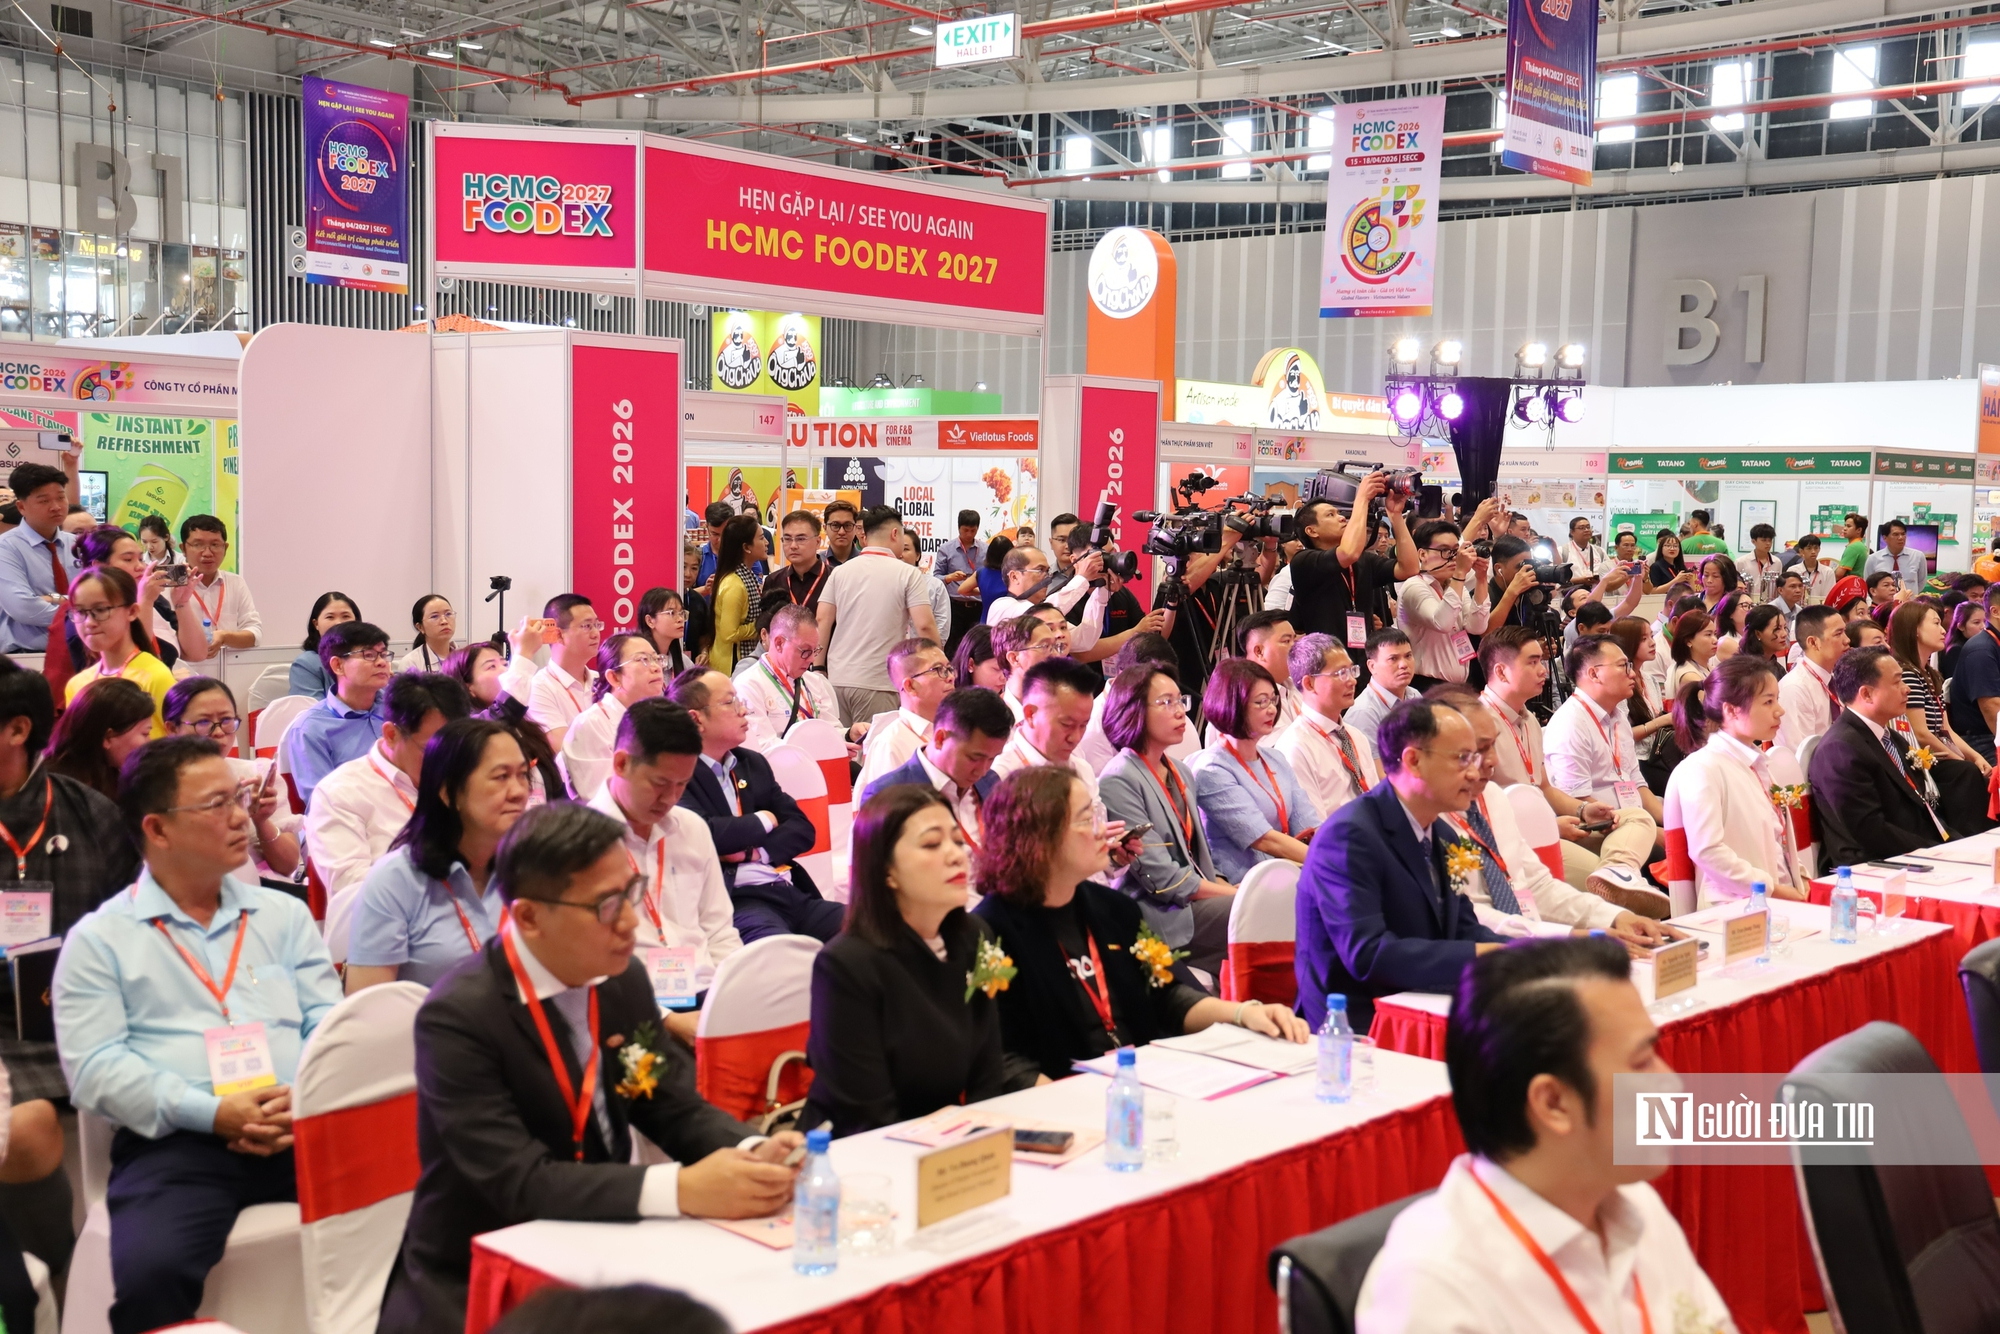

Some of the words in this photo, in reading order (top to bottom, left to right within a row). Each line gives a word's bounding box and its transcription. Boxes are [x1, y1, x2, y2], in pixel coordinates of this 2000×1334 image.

[954, 21, 1000, 46] EXIT
[957, 47, 979, 57] HALL
[982, 45, 992, 54] B1
[1525, 61, 1542, 77] Tháng
[1542, 67, 1563, 82] 04/2027
[1566, 75, 1579, 87] SECC
[318, 100, 331, 108] HẸN
[331, 101, 342, 110] GẶP
[343, 104, 352, 112] LẠI
[366, 108, 377, 116] YOU
[1353, 120, 1395, 135] HCMC
[1397, 122, 1420, 132] 2026
[329, 141, 368, 158] HCMC
[1402, 154, 1418, 162] SECC
[76, 142, 182, 243] B1
[341, 175, 376, 194] 2027
[463, 174, 560, 202] HCMC
[561, 184, 612, 203] 2027
[739, 186, 775, 215] HẸN
[779, 190, 815, 220] GẶP
[819, 198, 845, 224] LẠI
[858, 204, 887, 229] SEE
[889, 207, 922, 232] YOU
[926, 212, 974, 240] AGAIN
[327, 219, 345, 229] Tháng
[346, 221, 370, 231] 04/2027
[79, 239, 108, 254] Nam
[110, 242, 142, 261] Lng
[706, 218, 805, 261] HCMC
[814, 233, 928, 277] FOODEX
[938, 250, 998, 285] 2027
[1663, 275, 1769, 366] B1
[43, 368, 66, 377] 2026
[144, 379, 172, 392] CÔNG
[174, 383, 186, 392] TY
[188, 380, 201, 393] CỔ
[203, 381, 230, 395] PHẦN
[116, 415, 183, 435] INSTANT
[759, 415, 775, 425] 147
[886, 425, 898, 435] FOR
[900, 424, 913, 435] F&B
[970, 431, 1006, 442] Vietlotus
[1007, 431, 1034, 442] Foods
[96, 434, 201, 454] REFRESHMENT
[612, 399, 633, 484] 2026
[886, 436, 912, 446] CINEMA
[1236, 442, 1247, 450] 126
[1257, 439, 1274, 447] HCMC
[1107, 428, 1124, 496] 2026
[1407, 451, 1416, 459] 125
[1830, 459, 1861, 467] TATANO
[146, 491, 166, 505] lasuco
[904, 486, 935, 501] LOCAL
[894, 497, 935, 517] GLOBAL
